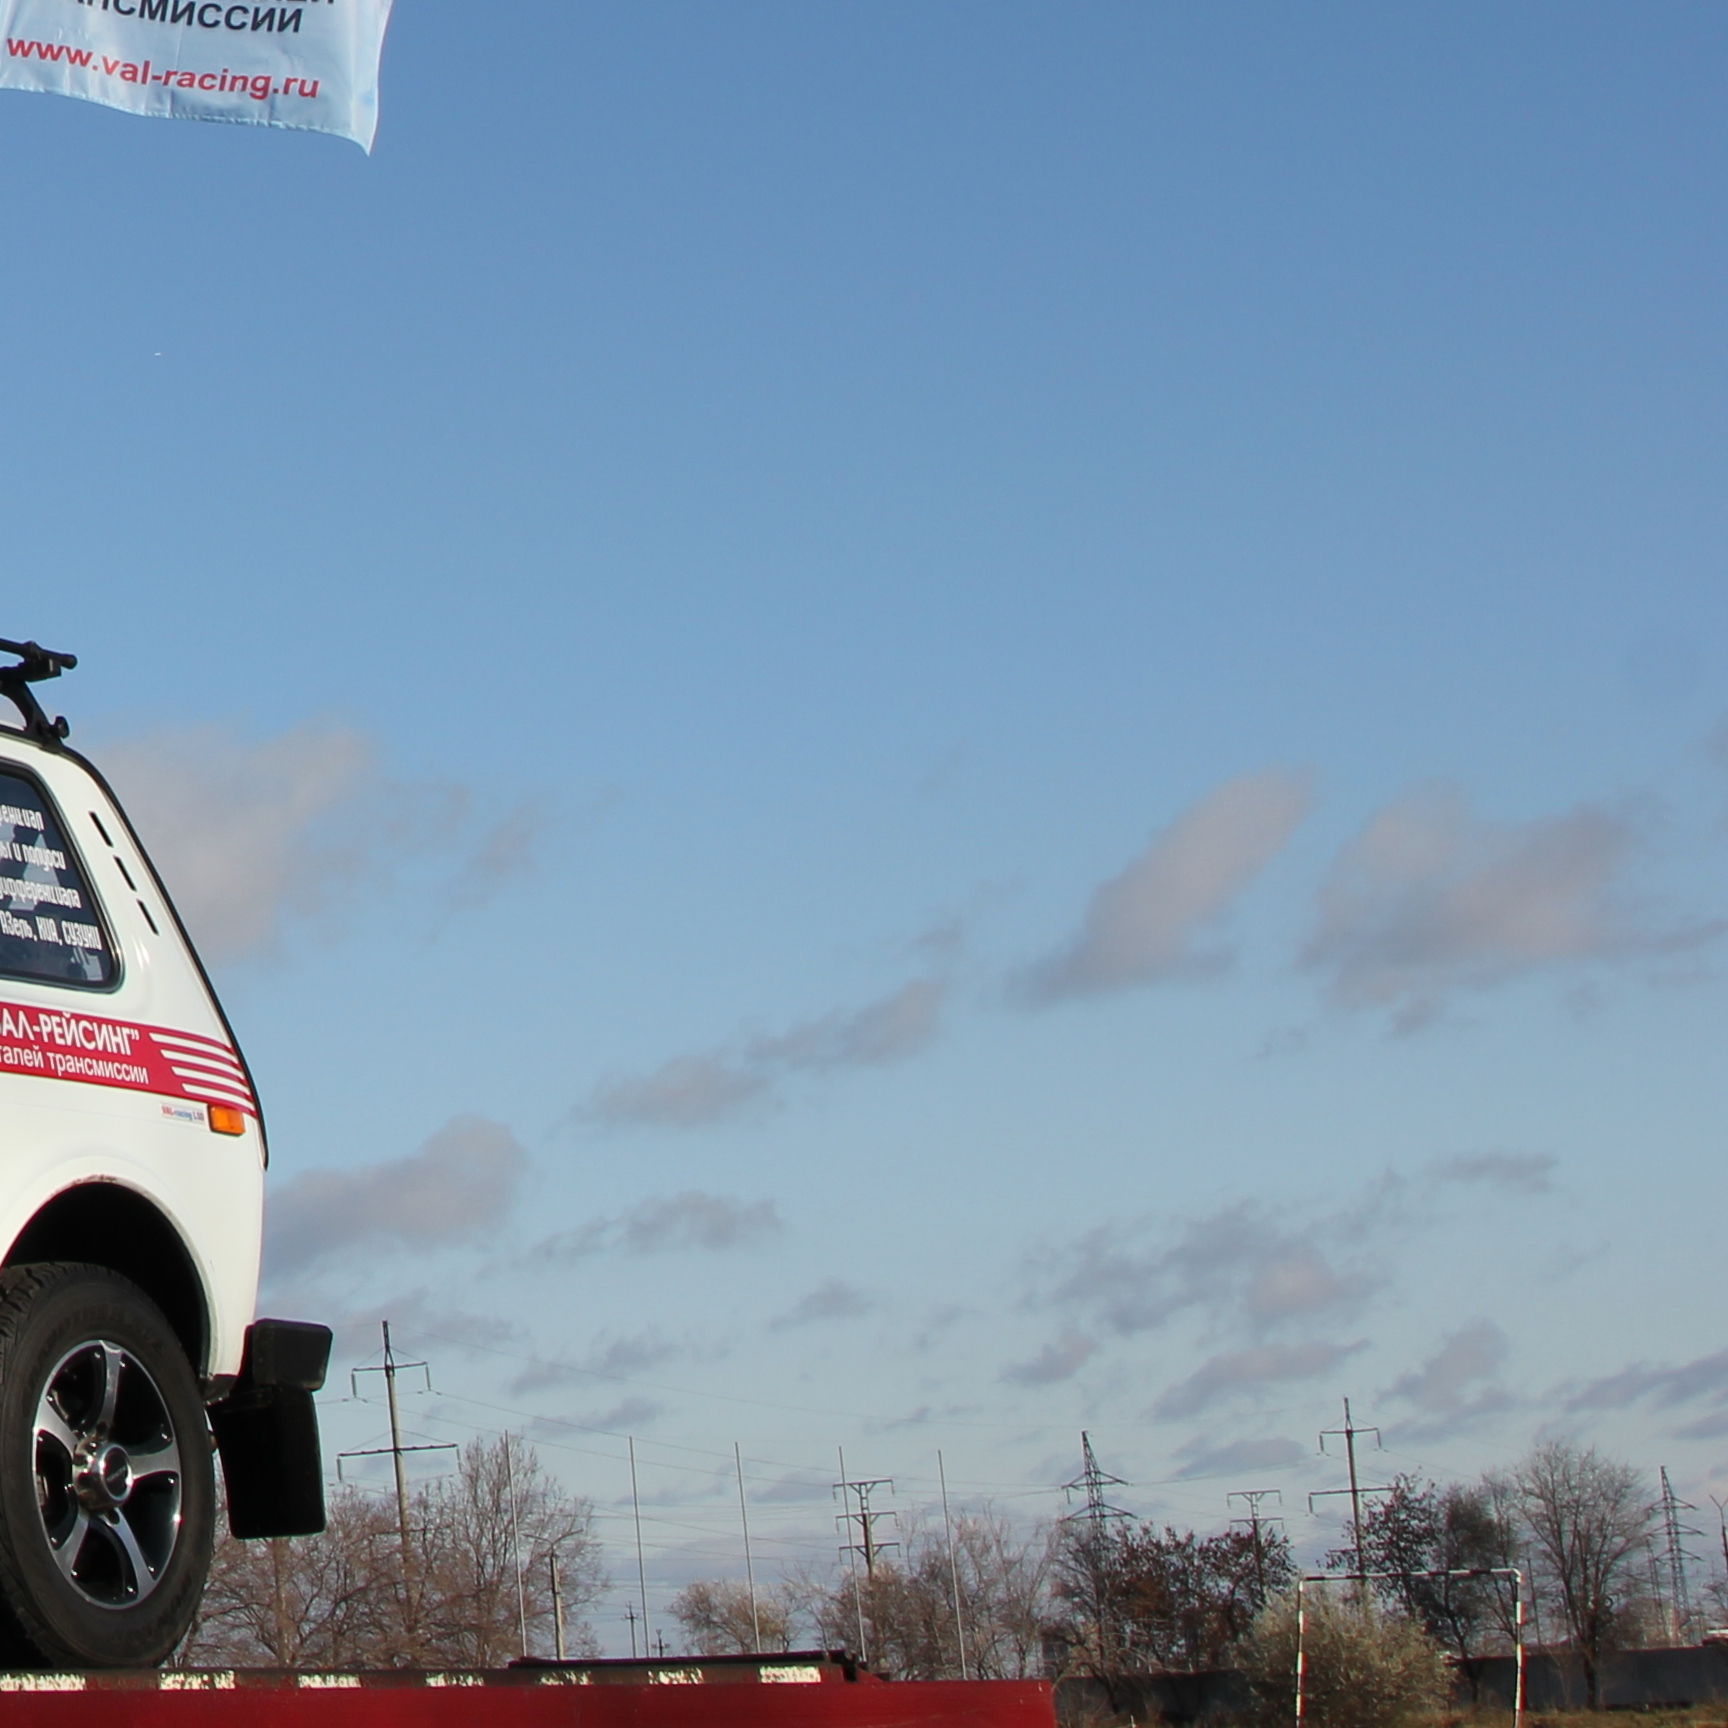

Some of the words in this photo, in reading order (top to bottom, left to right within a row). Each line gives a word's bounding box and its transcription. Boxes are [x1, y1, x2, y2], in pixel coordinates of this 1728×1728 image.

[7, 37, 321, 101] www.val-racing.ru
[12, 842, 22, 862] и
[22, 844, 66, 871] полуоси
[35, 915, 63, 945] КИА,
[46, 1051, 150, 1085] трансмиссии
